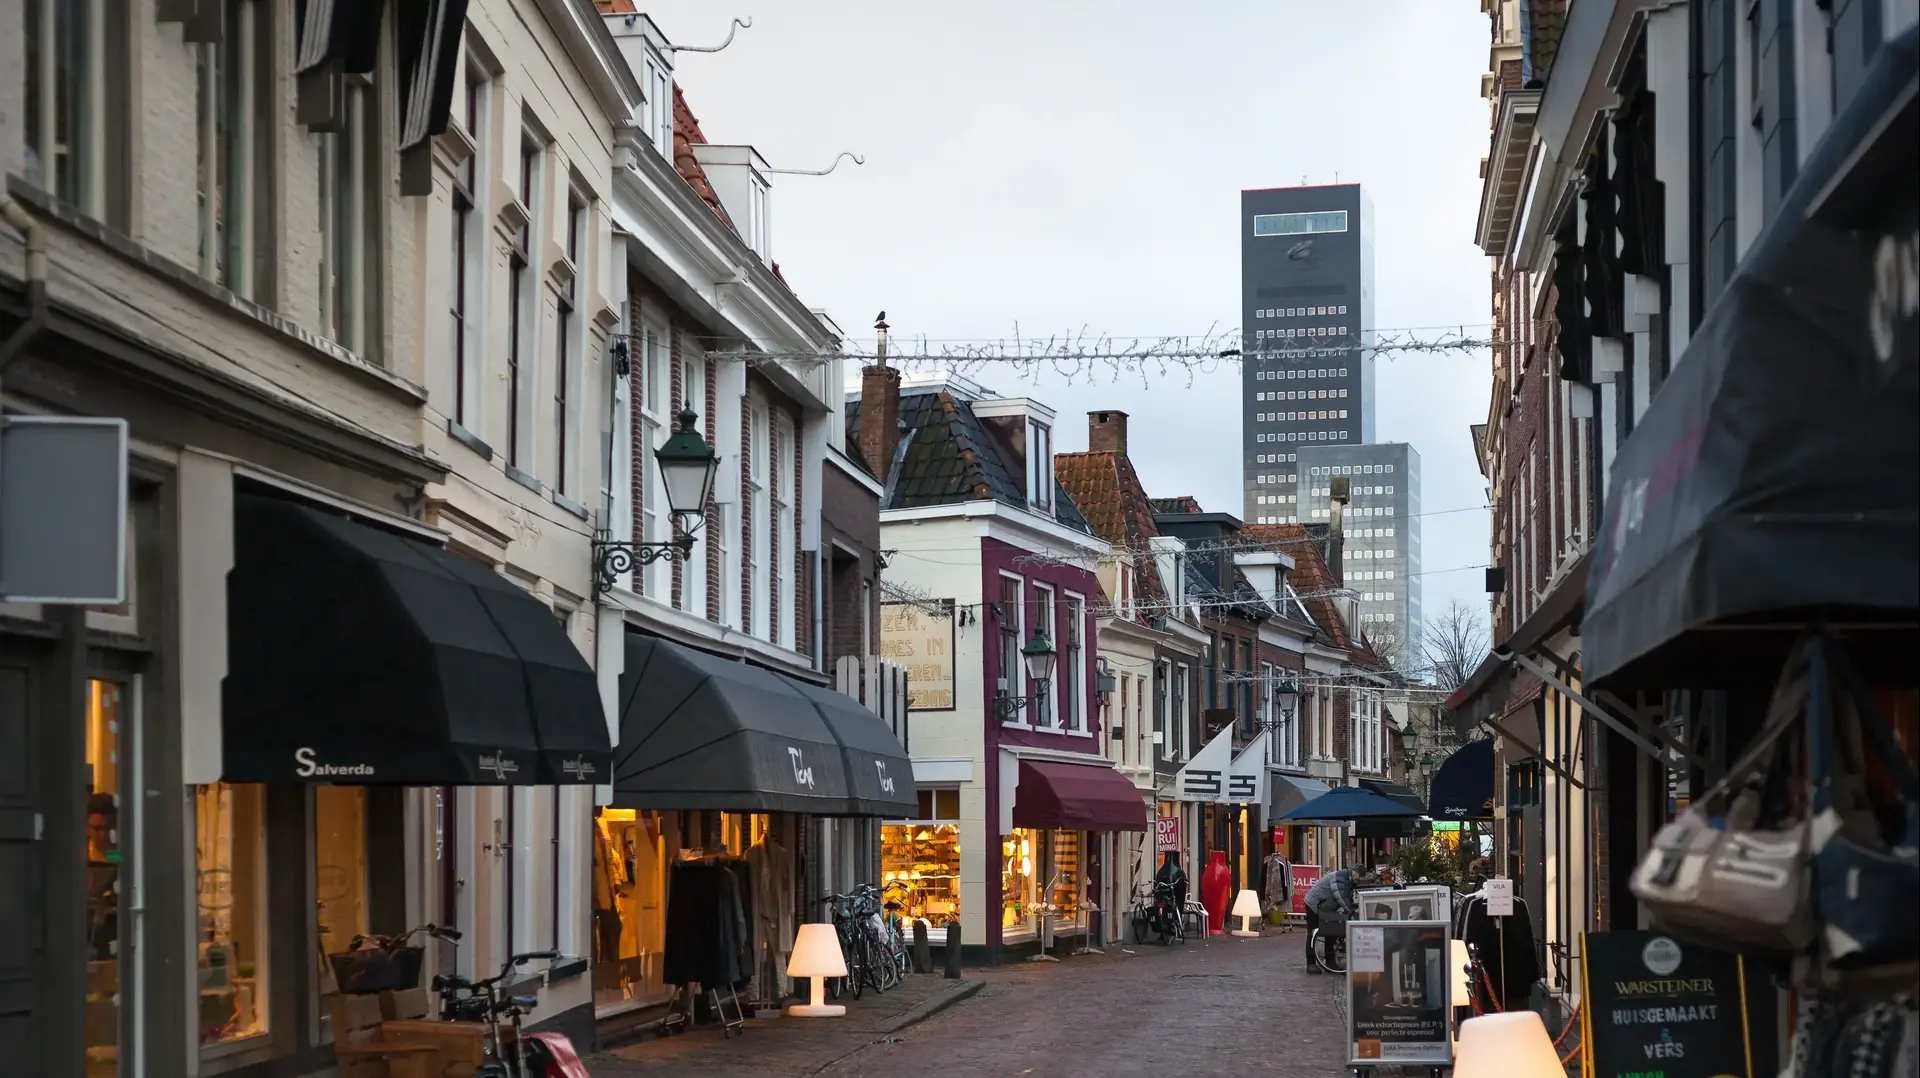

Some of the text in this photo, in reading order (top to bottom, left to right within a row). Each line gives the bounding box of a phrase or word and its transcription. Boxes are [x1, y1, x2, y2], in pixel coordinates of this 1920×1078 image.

[927, 638, 944, 655] IN
[295, 747, 374, 777] Salverda
[1158, 820, 1174, 833] OP
[1158, 833, 1176, 844] RUI
[1615, 979, 1714, 995] WARSTEINER
[1612, 1005, 1718, 1025] HUISGEMAAKT
[1644, 1042, 1684, 1059] VERS
